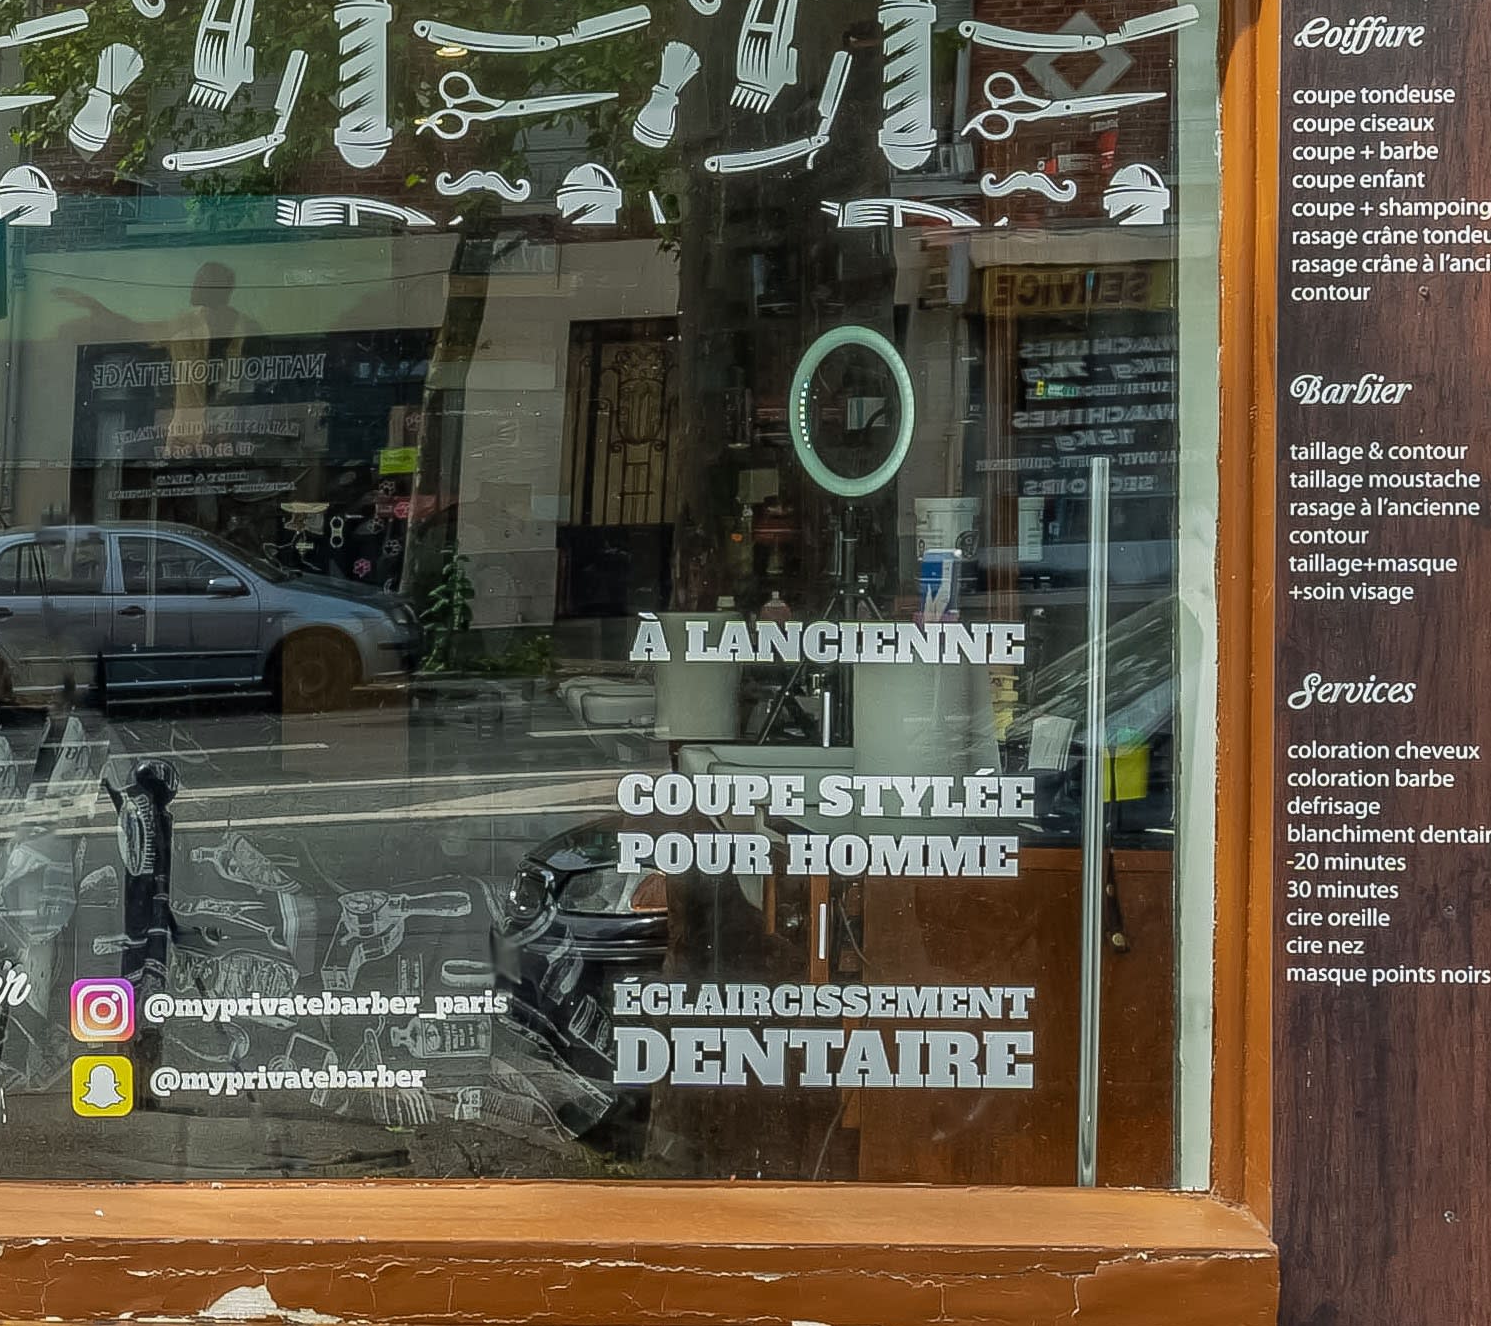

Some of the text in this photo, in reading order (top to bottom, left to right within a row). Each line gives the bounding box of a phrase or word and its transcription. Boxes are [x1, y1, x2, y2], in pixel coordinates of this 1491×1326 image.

[1293, 17, 1425, 55] Coiffure
[1292, 89, 1357, 109] coupe
[1359, 83, 1456, 104] tondeuse
[1292, 117, 1356, 137] coupe
[1359, 113, 1435, 132] ciseaux
[1292, 145, 1356, 165] coupe
[1379, 140, 1439, 161] barbe
[1291, 173, 1356, 193] coupe
[1359, 168, 1426, 189] enfant
[1291, 201, 1356, 221] coupe
[1292, 228, 1359, 250] rasage
[1361, 225, 1419, 245] crâne
[1291, 258, 1358, 278] rasage
[1361, 253, 1419, 273] crâne
[1421, 253, 1435, 273] à
[1290, 284, 1372, 302] contour
[1289, 373, 1413, 405] Barbier
[1289, 441, 1364, 465] taillage
[1387, 443, 1469, 460] contour
[1289, 469, 1364, 493] taillage
[1368, 468, 1481, 489] moustache
[1289, 501, 1356, 521] rasage
[1359, 497, 1372, 516] à
[1377, 496, 1481, 517] l'ancienne
[1289, 527, 1370, 545] contour
[1288, 552, 1458, 577] taillage+masque
[1288, 581, 1415, 605] +soin visage
[629, 612, 1026, 665] À LANCIENNE
[1287, 673, 1416, 709] Services
[1287, 739, 1390, 760] coloration
[1394, 740, 1481, 760] cheveux
[1287, 767, 1390, 788] coloration
[1395, 768, 1455, 788] barbe
[617, 767, 1036, 818] COUPE STYLÉE
[1286, 795, 1381, 820] defrisage
[1287, 823, 1416, 844] blanchiment
[617, 831, 1019, 877] POUR HOMME
[1286, 852, 1320, 871] -20
[1324, 852, 1407, 872] minutes
[1286, 880, 1312, 899] 30
[1316, 880, 1399, 900] minutes
[1286, 907, 1324, 927] cire
[1327, 907, 1391, 927] oreille
[1286, 935, 1323, 954] cire
[1328, 940, 1365, 955] nez
[1286, 967, 1367, 987] masque
[1372, 964, 1436, 987] points
[1441, 965, 1491, 984] noirs
[145, 990, 509, 1022] @myprivatebarber_paris
[612, 976, 1036, 1020] ÉCLAIRCISSEMENT
[612, 1026, 1035, 1090] DENTAIRE
[150, 1064, 426, 1096] @myprivatebarber
